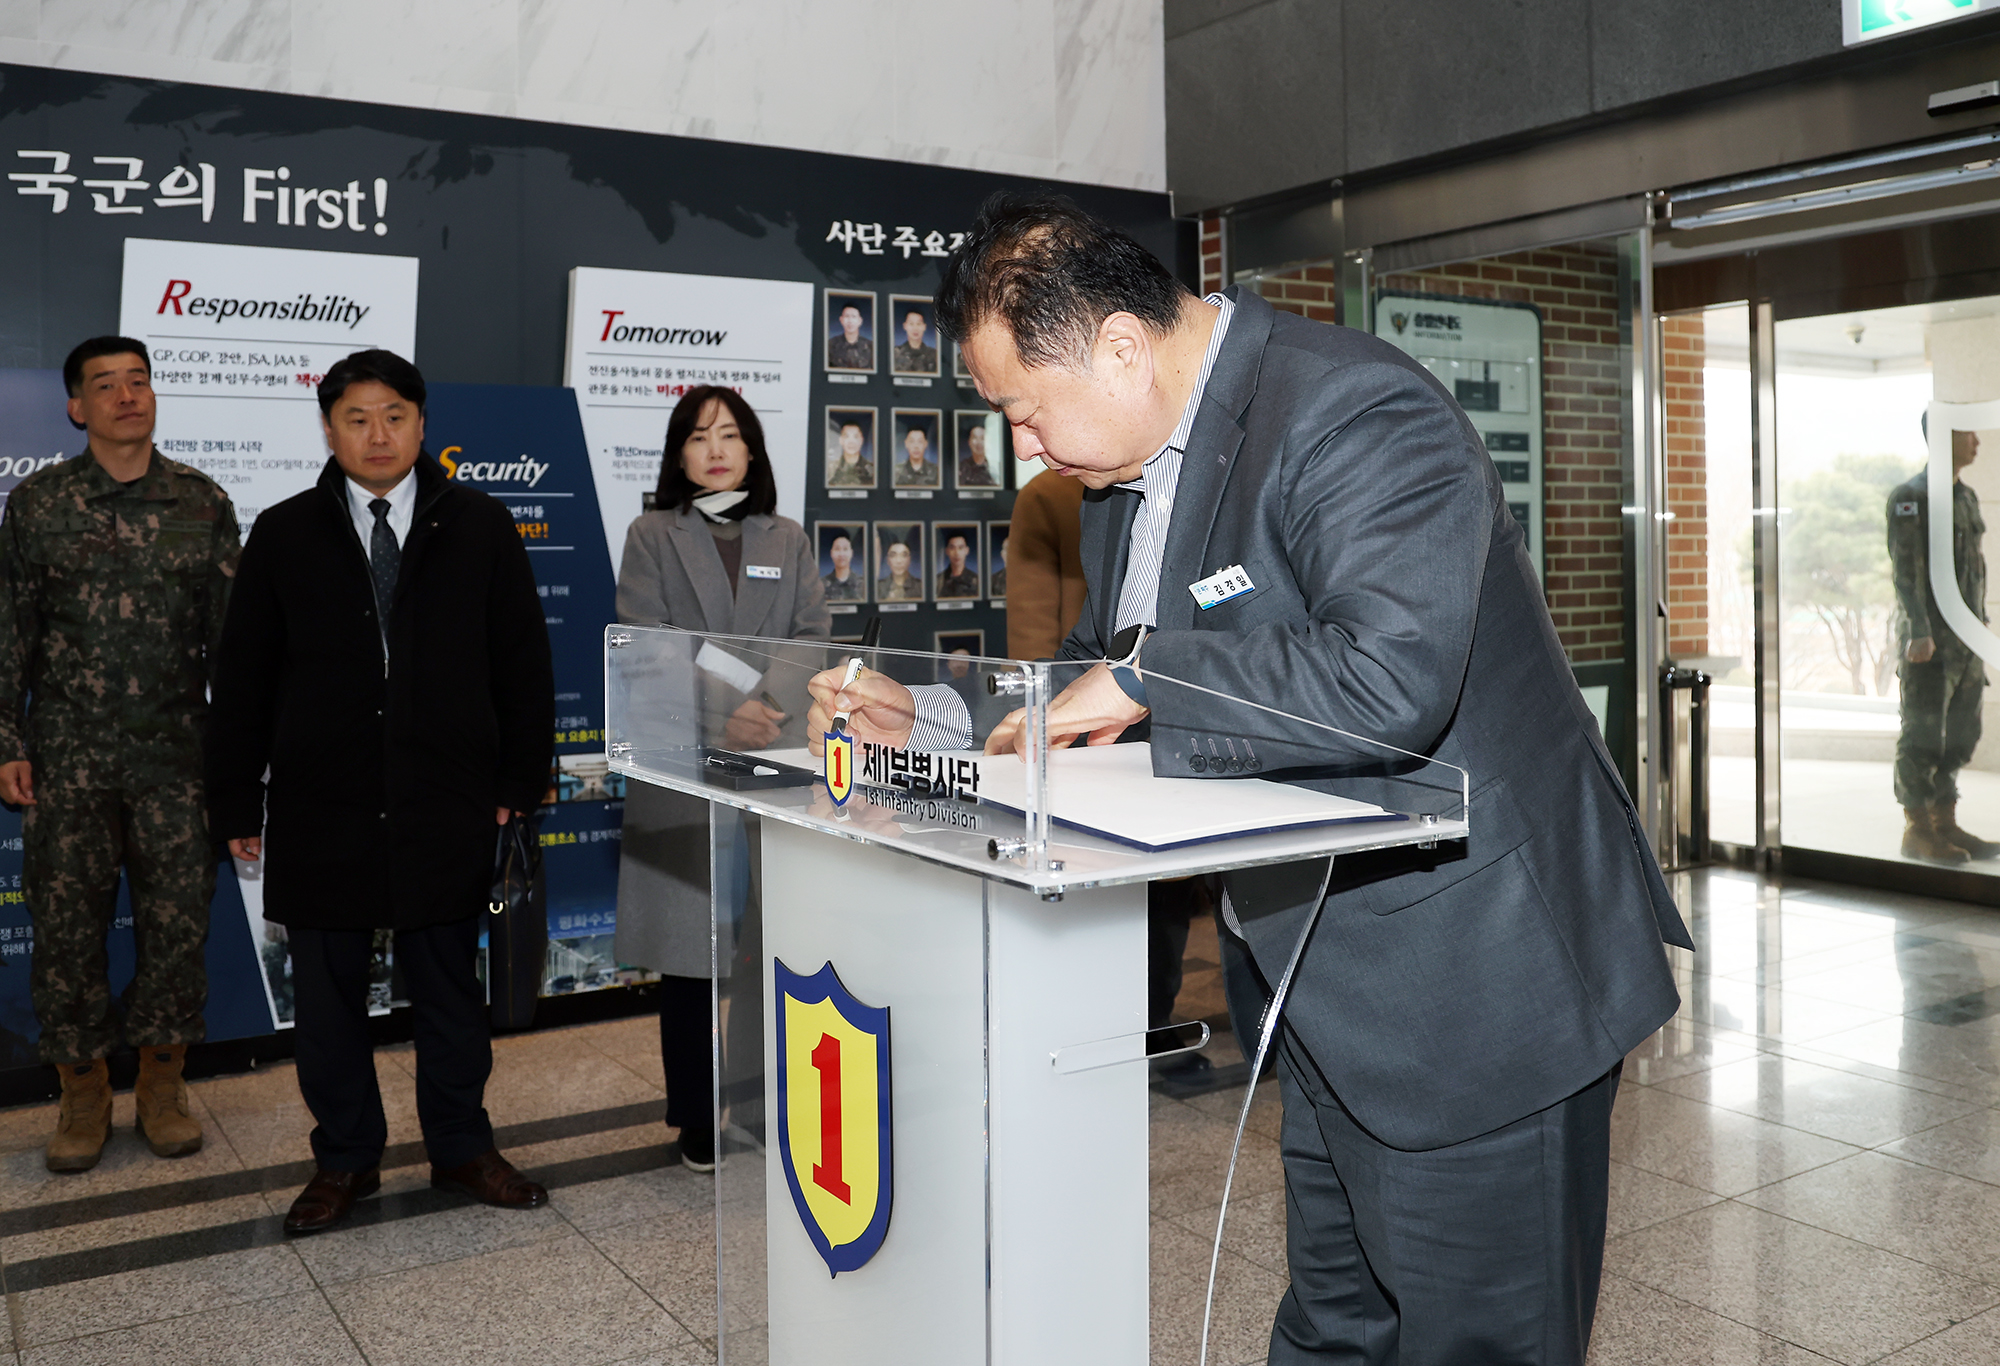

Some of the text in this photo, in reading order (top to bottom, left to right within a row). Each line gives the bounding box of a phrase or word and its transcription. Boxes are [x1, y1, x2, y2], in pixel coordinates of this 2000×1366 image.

[7, 150, 388, 236] 국군의 First!
[825, 220, 887, 255] 사단
[157, 279, 369, 329] Responsibility
[600, 310, 727, 345] Tomorrow
[179, 350, 213, 364] GOP,
[153, 370, 193, 383] 다양한
[197, 372, 222, 384] 경계
[225, 373, 288, 387] 임무수행의
[588, 383, 618, 396] 관문을
[730, 371, 750, 382] 평화
[752, 371, 781, 383] 통일의
[163, 439, 263, 453] 최전방 경계의 시작
[439, 445, 549, 488] Security
[863, 743, 980, 804] 제1보병사단
[866, 787, 977, 830] 1st Infantry Division
[811, 1032, 851, 1206] 1
